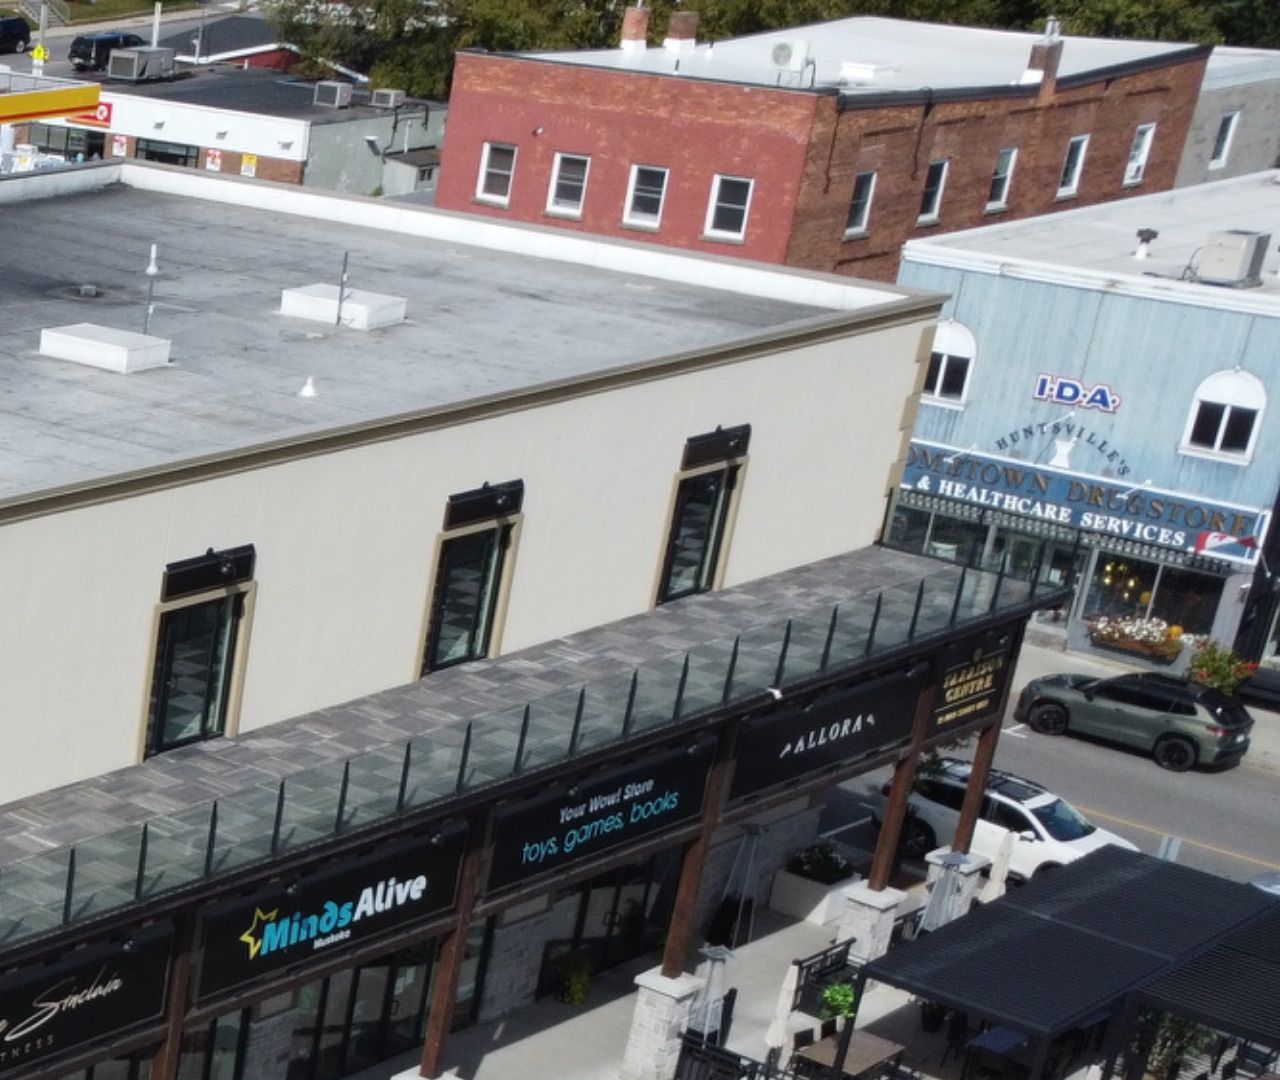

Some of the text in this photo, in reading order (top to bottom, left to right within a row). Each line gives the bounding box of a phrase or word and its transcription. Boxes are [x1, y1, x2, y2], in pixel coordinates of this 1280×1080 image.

[995, 421, 1131, 477] HUNTSVILLE'S
[917, 475, 1186, 546] & HEALTHCARE SERVICES
[794, 714, 864, 754] ALLORA
[559, 804, 587, 825] Your
[623, 777, 655, 800] Store
[630, 789, 679, 824] books
